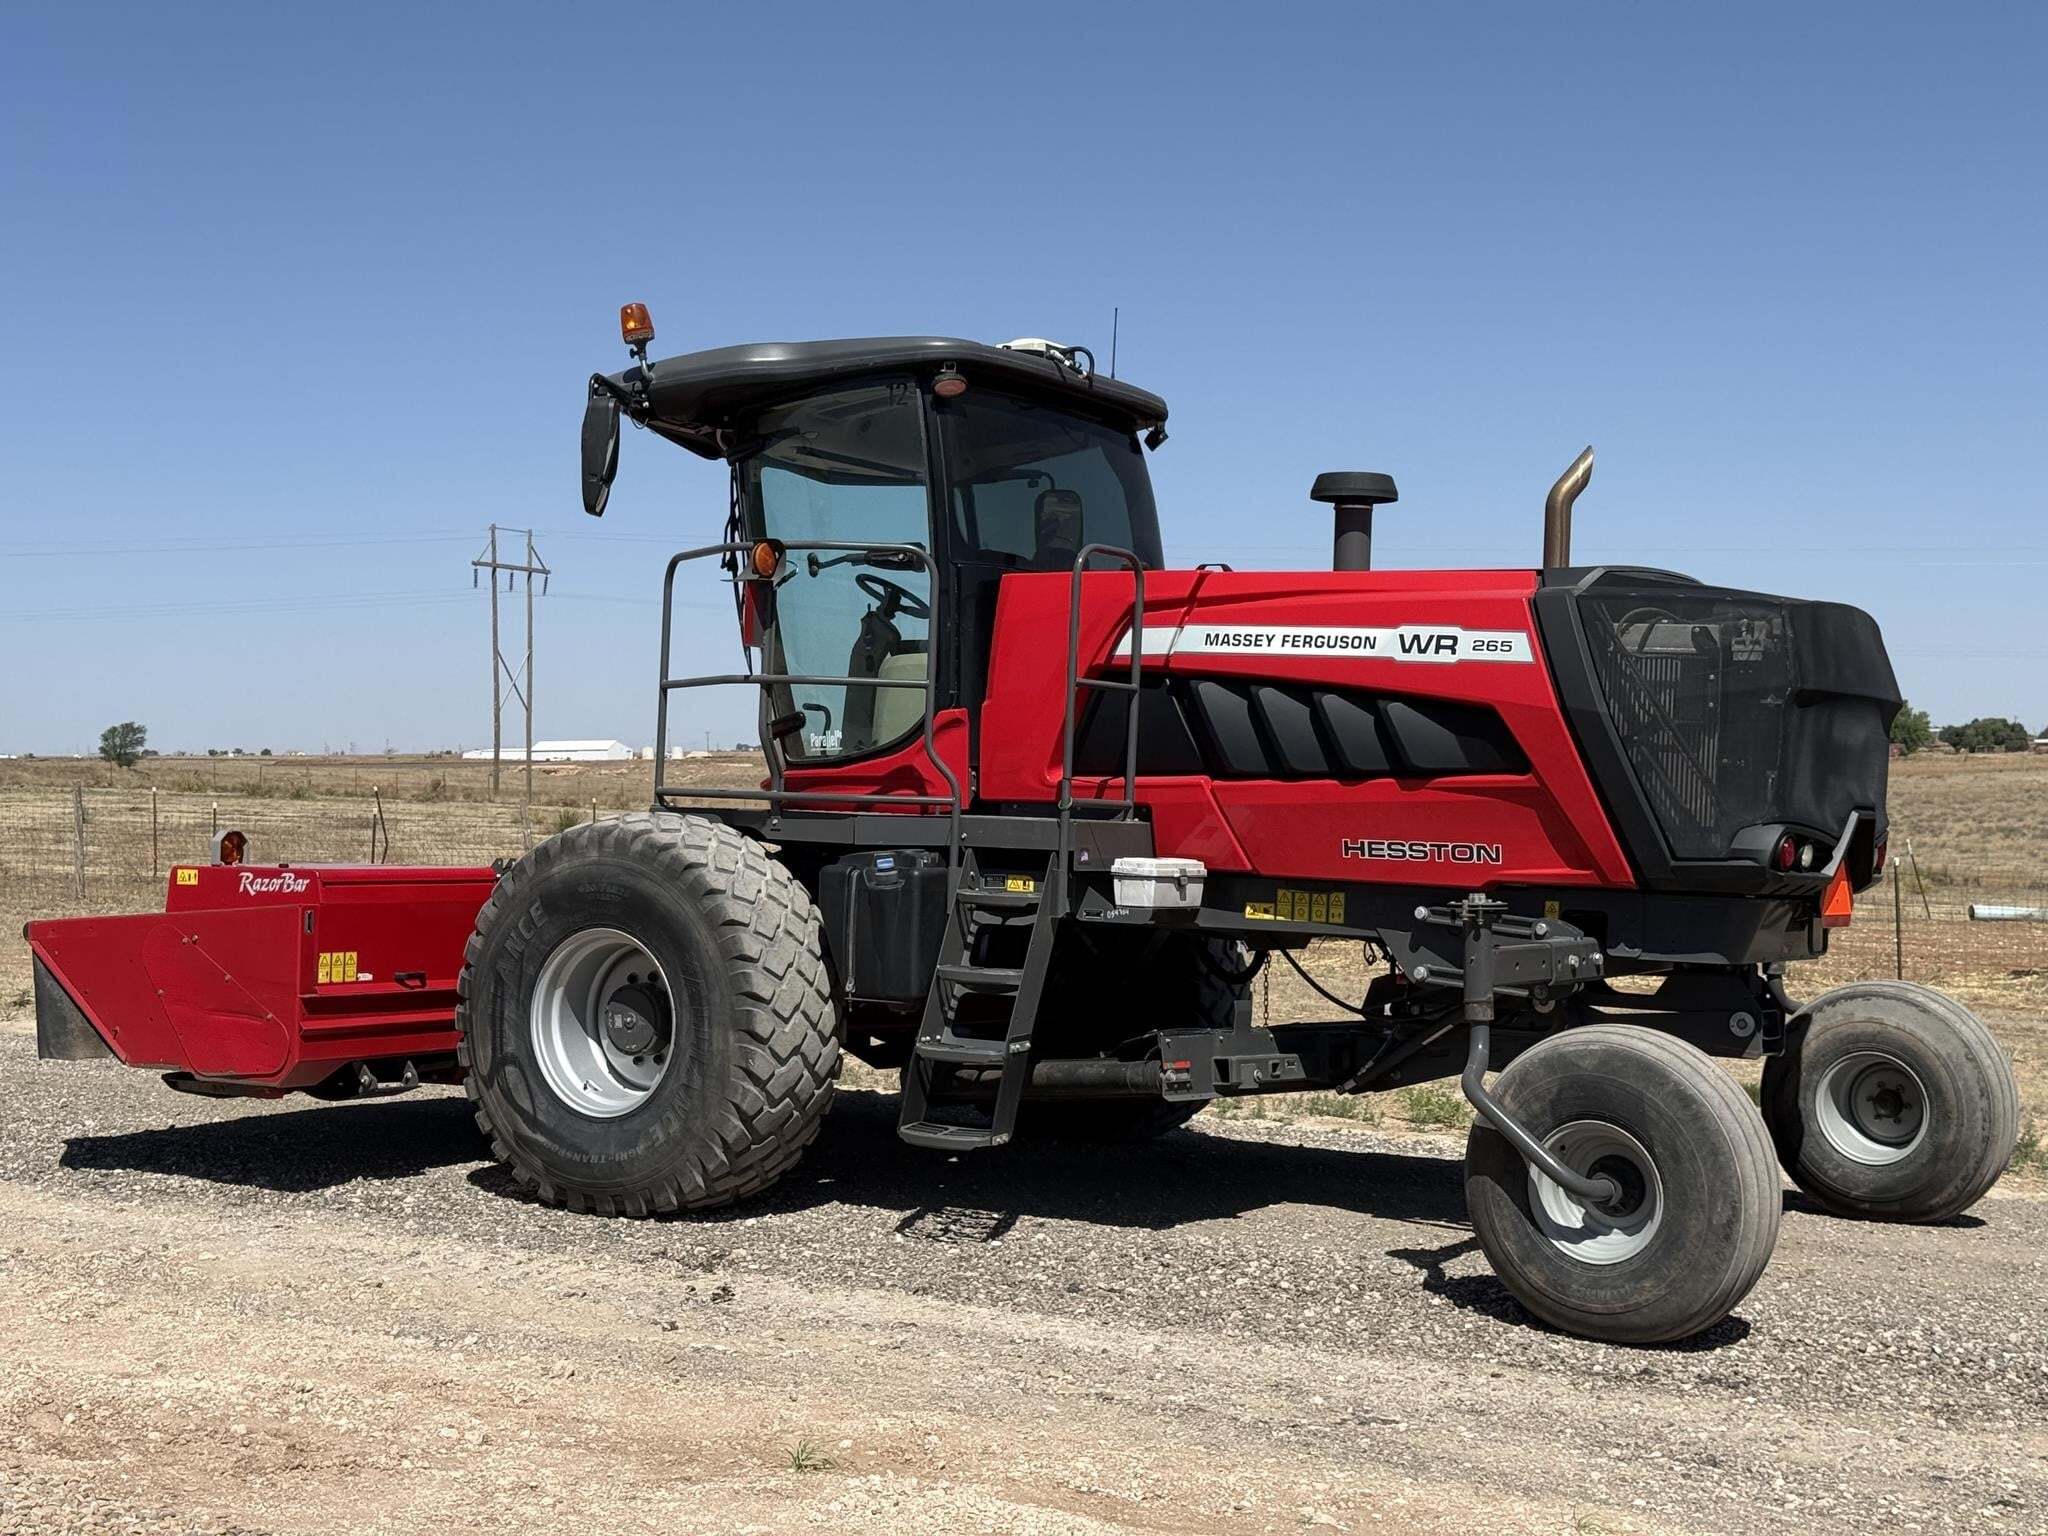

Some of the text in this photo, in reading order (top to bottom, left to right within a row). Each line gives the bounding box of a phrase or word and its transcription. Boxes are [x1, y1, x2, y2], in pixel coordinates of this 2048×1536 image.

[1204, 632, 1513, 656] MASSEY FERGUSON WR 265
[1342, 838, 1503, 865] HESSTON
[238, 871, 310, 897] RazorBar
